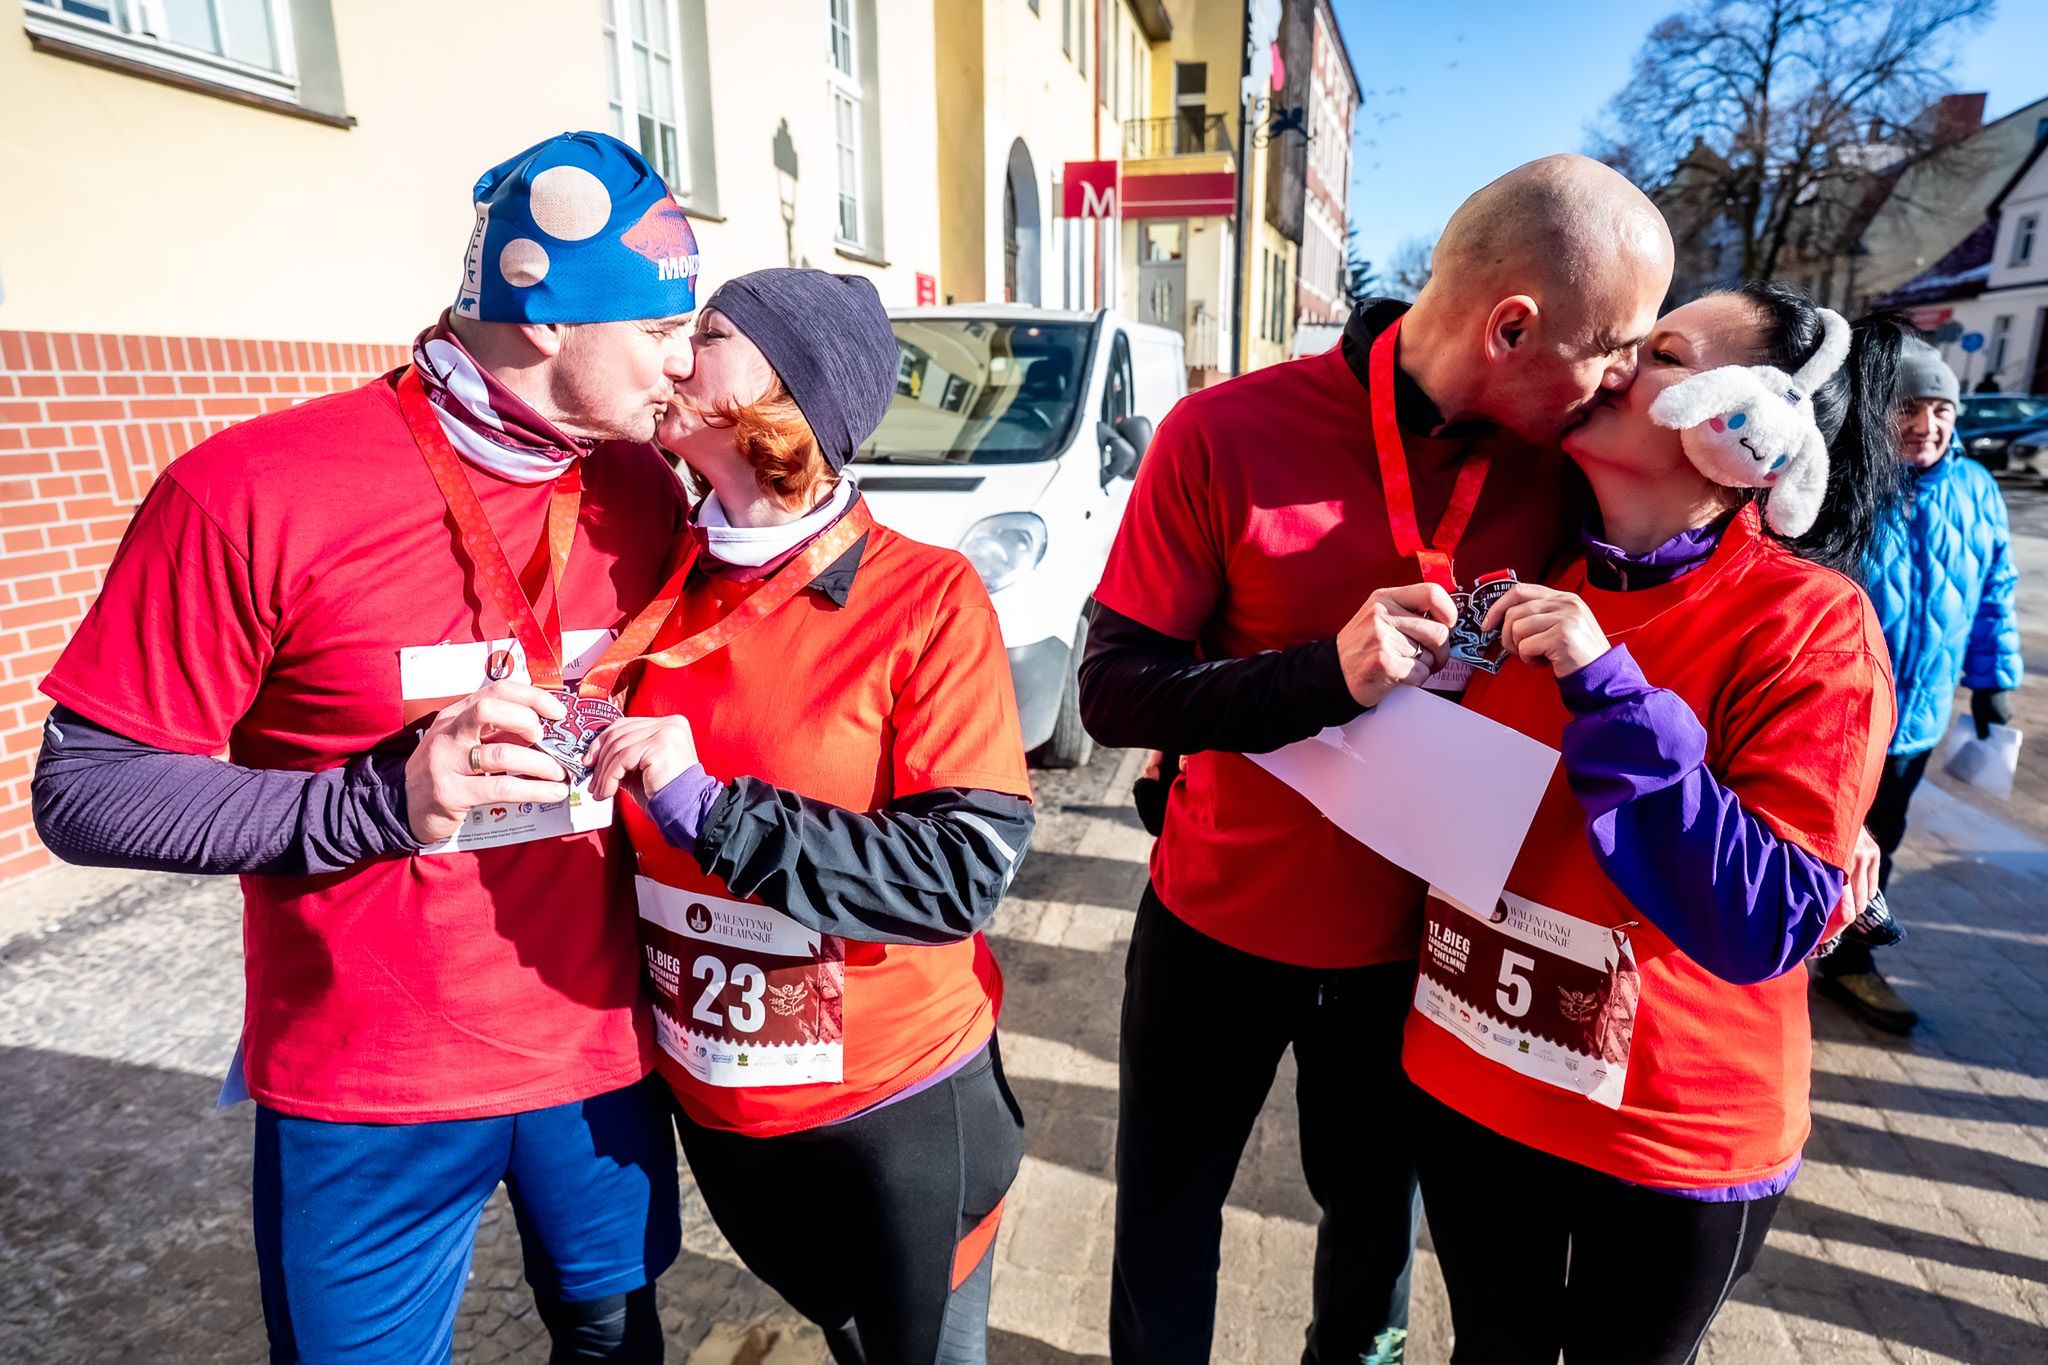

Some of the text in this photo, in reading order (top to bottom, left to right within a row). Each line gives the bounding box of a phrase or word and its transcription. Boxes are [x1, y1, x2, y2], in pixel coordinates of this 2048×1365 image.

[1079, 180, 1116, 217] M
[714, 911, 773, 932] WALENTYNKI
[691, 954, 768, 1034] 23
[1495, 948, 1536, 1018] 5
